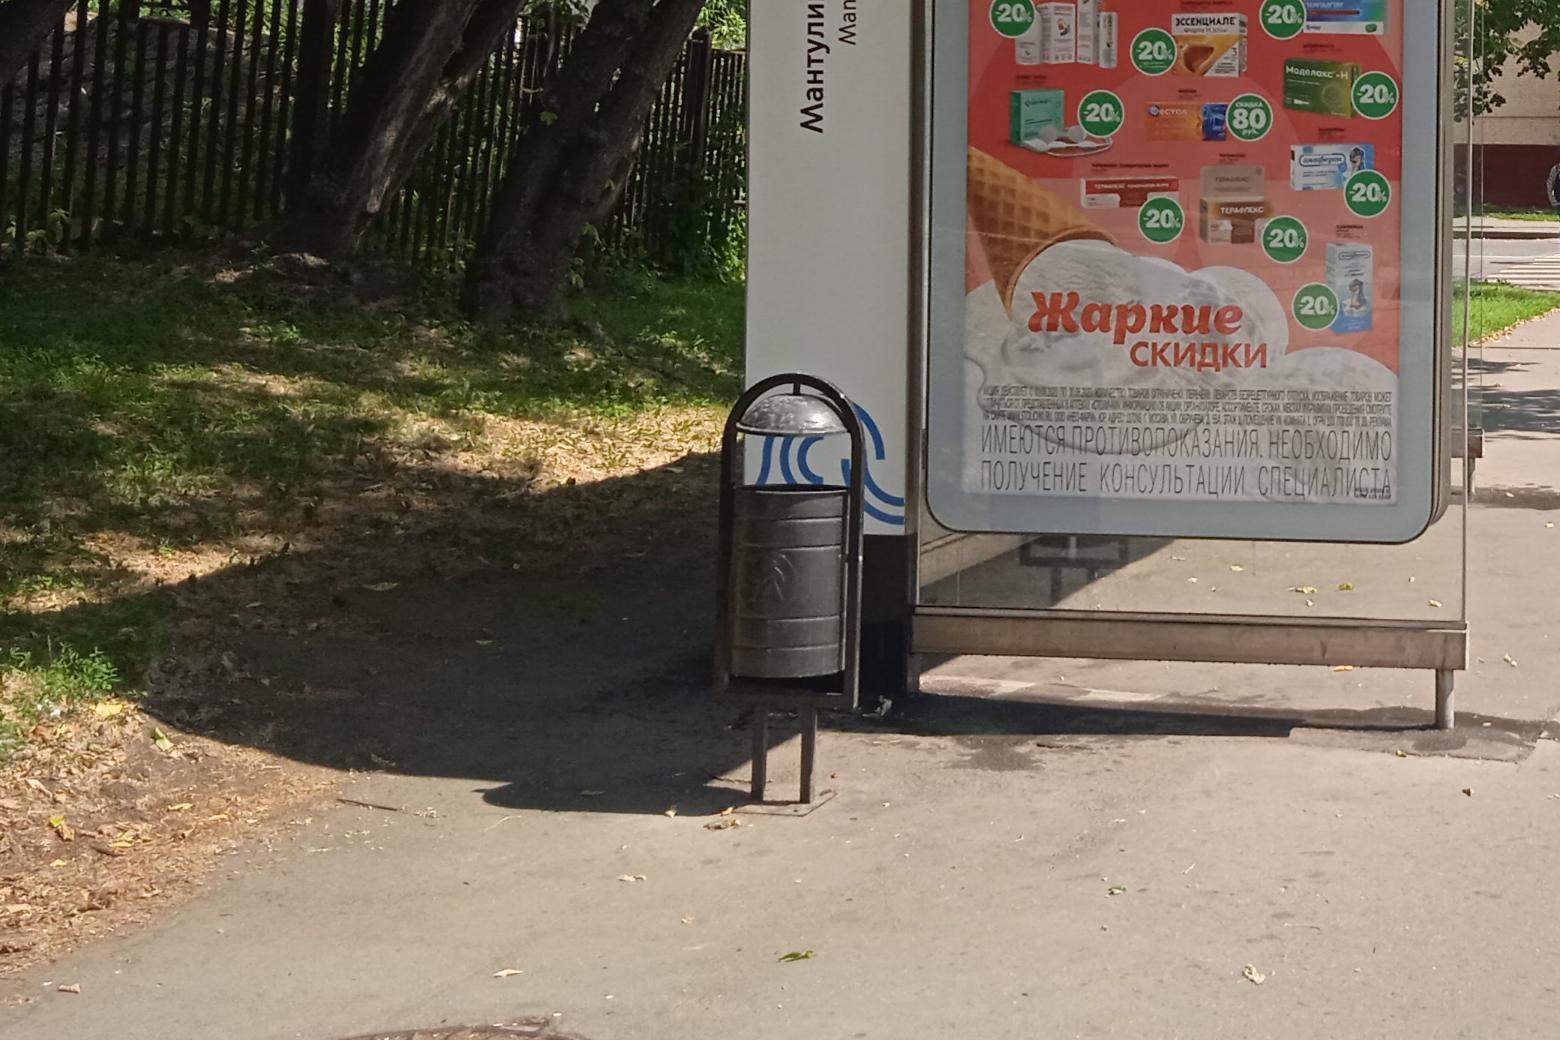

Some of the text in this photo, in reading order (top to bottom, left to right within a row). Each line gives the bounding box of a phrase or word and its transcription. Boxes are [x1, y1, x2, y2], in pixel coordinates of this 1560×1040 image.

[1175, 16, 1237, 27] ЭССЕНЦИАЛЕ
[1232, 108, 1267, 129] 80
[1028, 291, 1243, 344] Жаркие
[981, 425, 1392, 462] ИМЕЮТСЯ ПРОТИВОПОКАЗАНИЯ. НЕОБХОДИМО
[981, 461, 1088, 492] ПОЛУЧЕНИЕ
[1100, 462, 1246, 497] КОНСУЛЬТАЦИИ
[1258, 466, 1391, 498] СПЕЦИАЛИСТА
